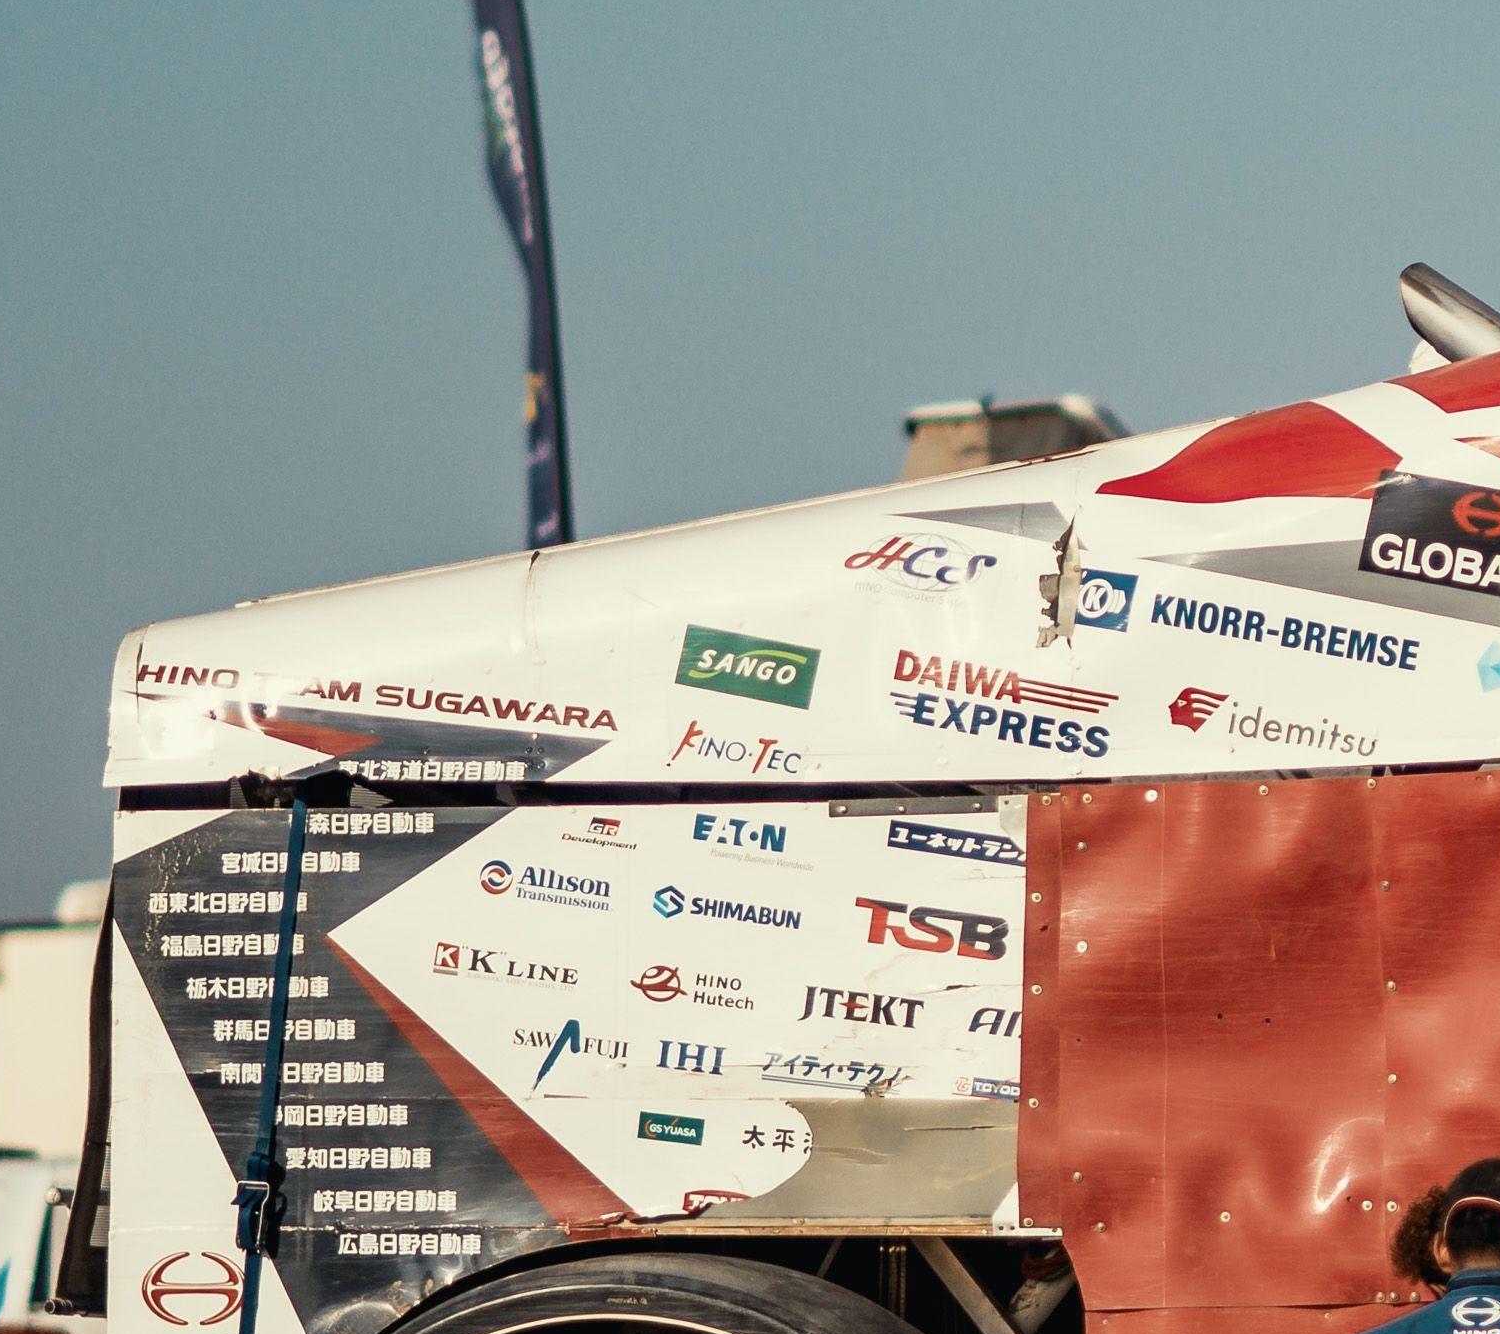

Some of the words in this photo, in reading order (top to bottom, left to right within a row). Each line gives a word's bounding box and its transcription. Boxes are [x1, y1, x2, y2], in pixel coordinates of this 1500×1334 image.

[1150, 593, 1421, 672] KNORR-BREMSE
[697, 649, 799, 687] SANGO
[893, 648, 1022, 704] DAIWA
[137, 663, 240, 690] HINO
[375, 684, 619, 733] SUGAWARA
[911, 692, 1112, 759] EXPRESS
[1227, 701, 1379, 757] idemitsu
[288, 812, 435, 835] 森日野自動車
[560, 831, 639, 852] Development
[517, 865, 611, 898] Allison
[514, 886, 611, 913] Transmission
[690, 896, 803, 931] SHIMABUN
[854, 896, 1010, 961] TSB
[505, 959, 579, 985] LINE
[695, 973, 743, 991] HINO
[693, 990, 755, 1011] Hutech
[800, 984, 925, 1030] JTEKT
[656, 1039, 728, 1076] IHI
[219, 1062, 387, 1085] 南関日野自動車
[274, 1104, 409, 1127] 岡日野自動車
[648, 1122, 664, 1135] GS
[662, 1124, 697, 1138] YUASA
[284, 1146, 433, 1170] 愛知日野自動車
[312, 1189, 458, 1213] 岐阜日野自動車
[337, 1232, 483, 1257] 広島日野自動車
